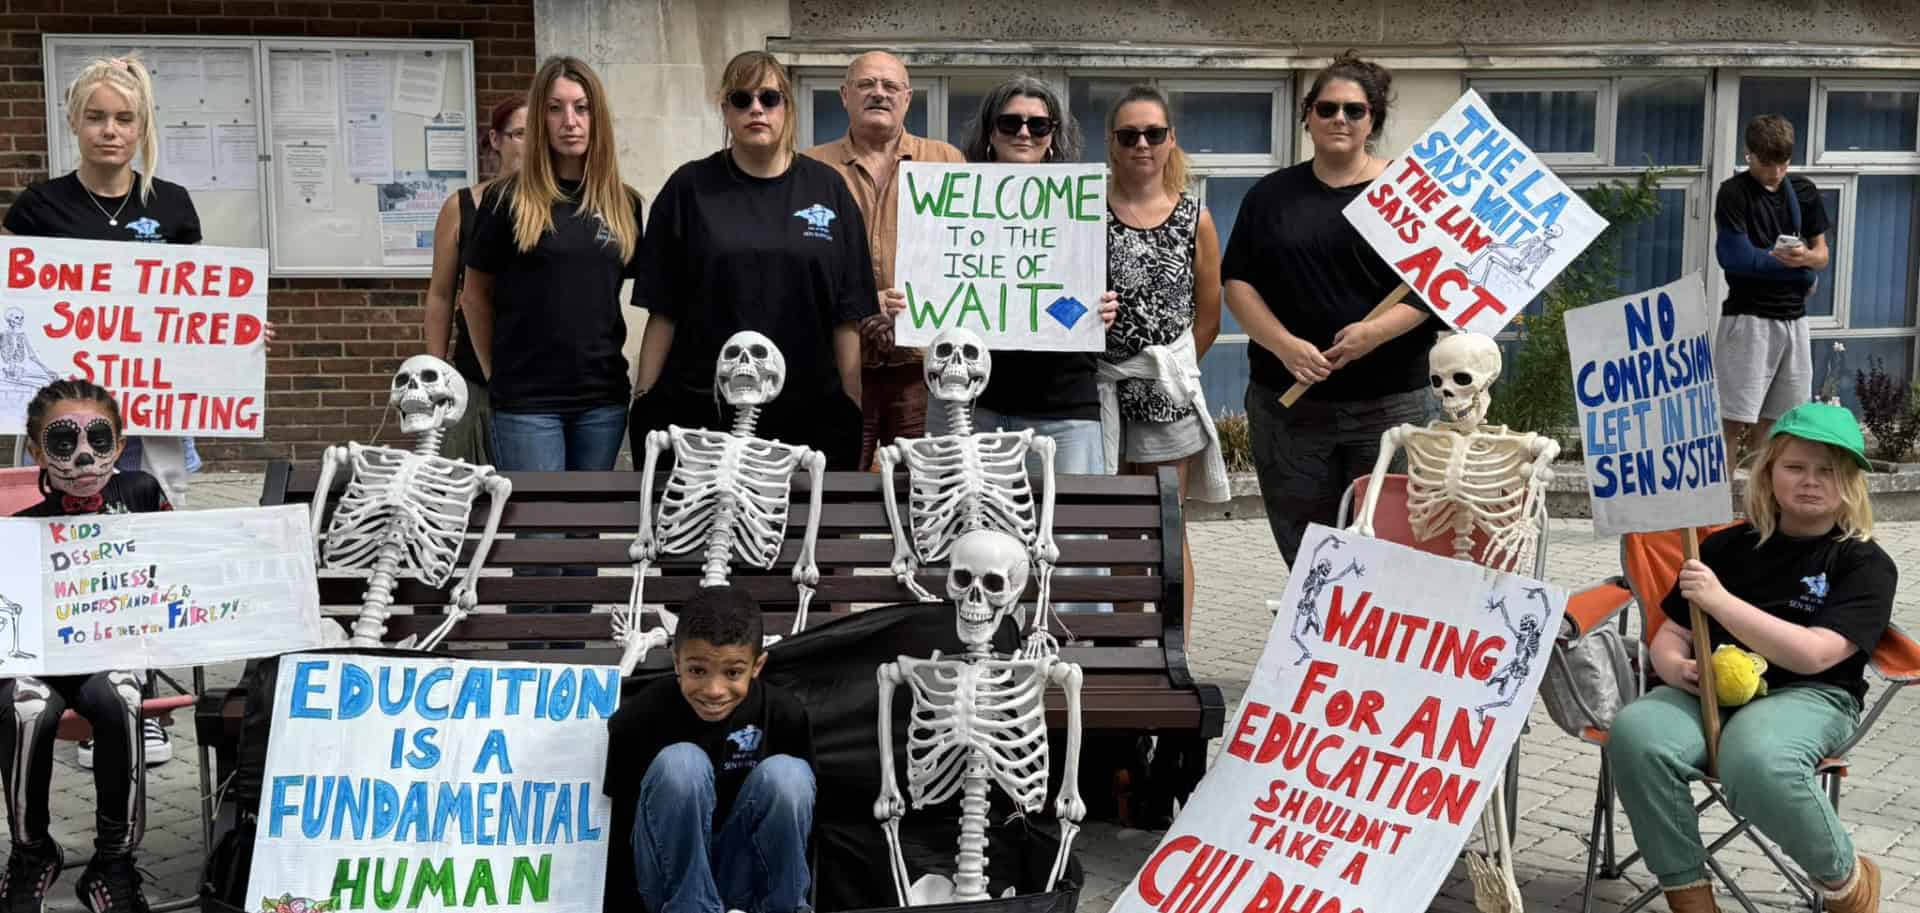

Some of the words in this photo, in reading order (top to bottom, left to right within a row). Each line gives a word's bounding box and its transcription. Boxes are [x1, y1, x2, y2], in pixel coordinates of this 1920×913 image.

[907, 171, 1103, 221] WELCOME
[1412, 131, 1481, 196] SAYS
[1470, 184, 1538, 245] WAIT
[1454, 104, 1527, 187] THE
[1508, 169, 1570, 228] LA
[947, 226, 985, 247] TO
[1003, 226, 1056, 248] THE
[1367, 184, 1426, 244] SAYS
[1395, 156, 1449, 213] THE
[1435, 204, 1493, 255] LAW
[8, 247, 112, 292] BONE
[134, 259, 254, 297] TIRED
[944, 253, 1006, 279] ISLE
[1017, 254, 1048, 279] OF
[1395, 246, 1507, 329] ACT
[43, 301, 142, 342] SOUL
[154, 307, 262, 345] TIRED
[905, 281, 1064, 332] WAIT
[1624, 291, 1675, 350] NO
[69, 351, 172, 389] STILL
[1576, 330, 1714, 407] COMPASSION
[110, 391, 260, 431] IGHTING
[1586, 401, 1652, 456] LEFT
[1660, 395, 1685, 446] IN
[1685, 383, 1718, 438] THE
[1592, 449, 1657, 498] SEN
[1661, 434, 1727, 491] SYSTEM
[1322, 586, 1506, 680] WAITING
[289, 660, 621, 722] EDUCATION
[1290, 660, 1385, 735] FOR
[1391, 696, 1496, 768] AN
[390, 727, 441, 770] IS
[473, 729, 513, 774] A
[1227, 702, 1480, 825] EDUCATION
[268, 775, 601, 846] FUNDAMENTAL
[1254, 779, 1413, 855] SHOULDN'T
[1248, 814, 1334, 868] TAKE
[1340, 851, 1369, 885] A
[330, 853, 553, 911] HUMAN
